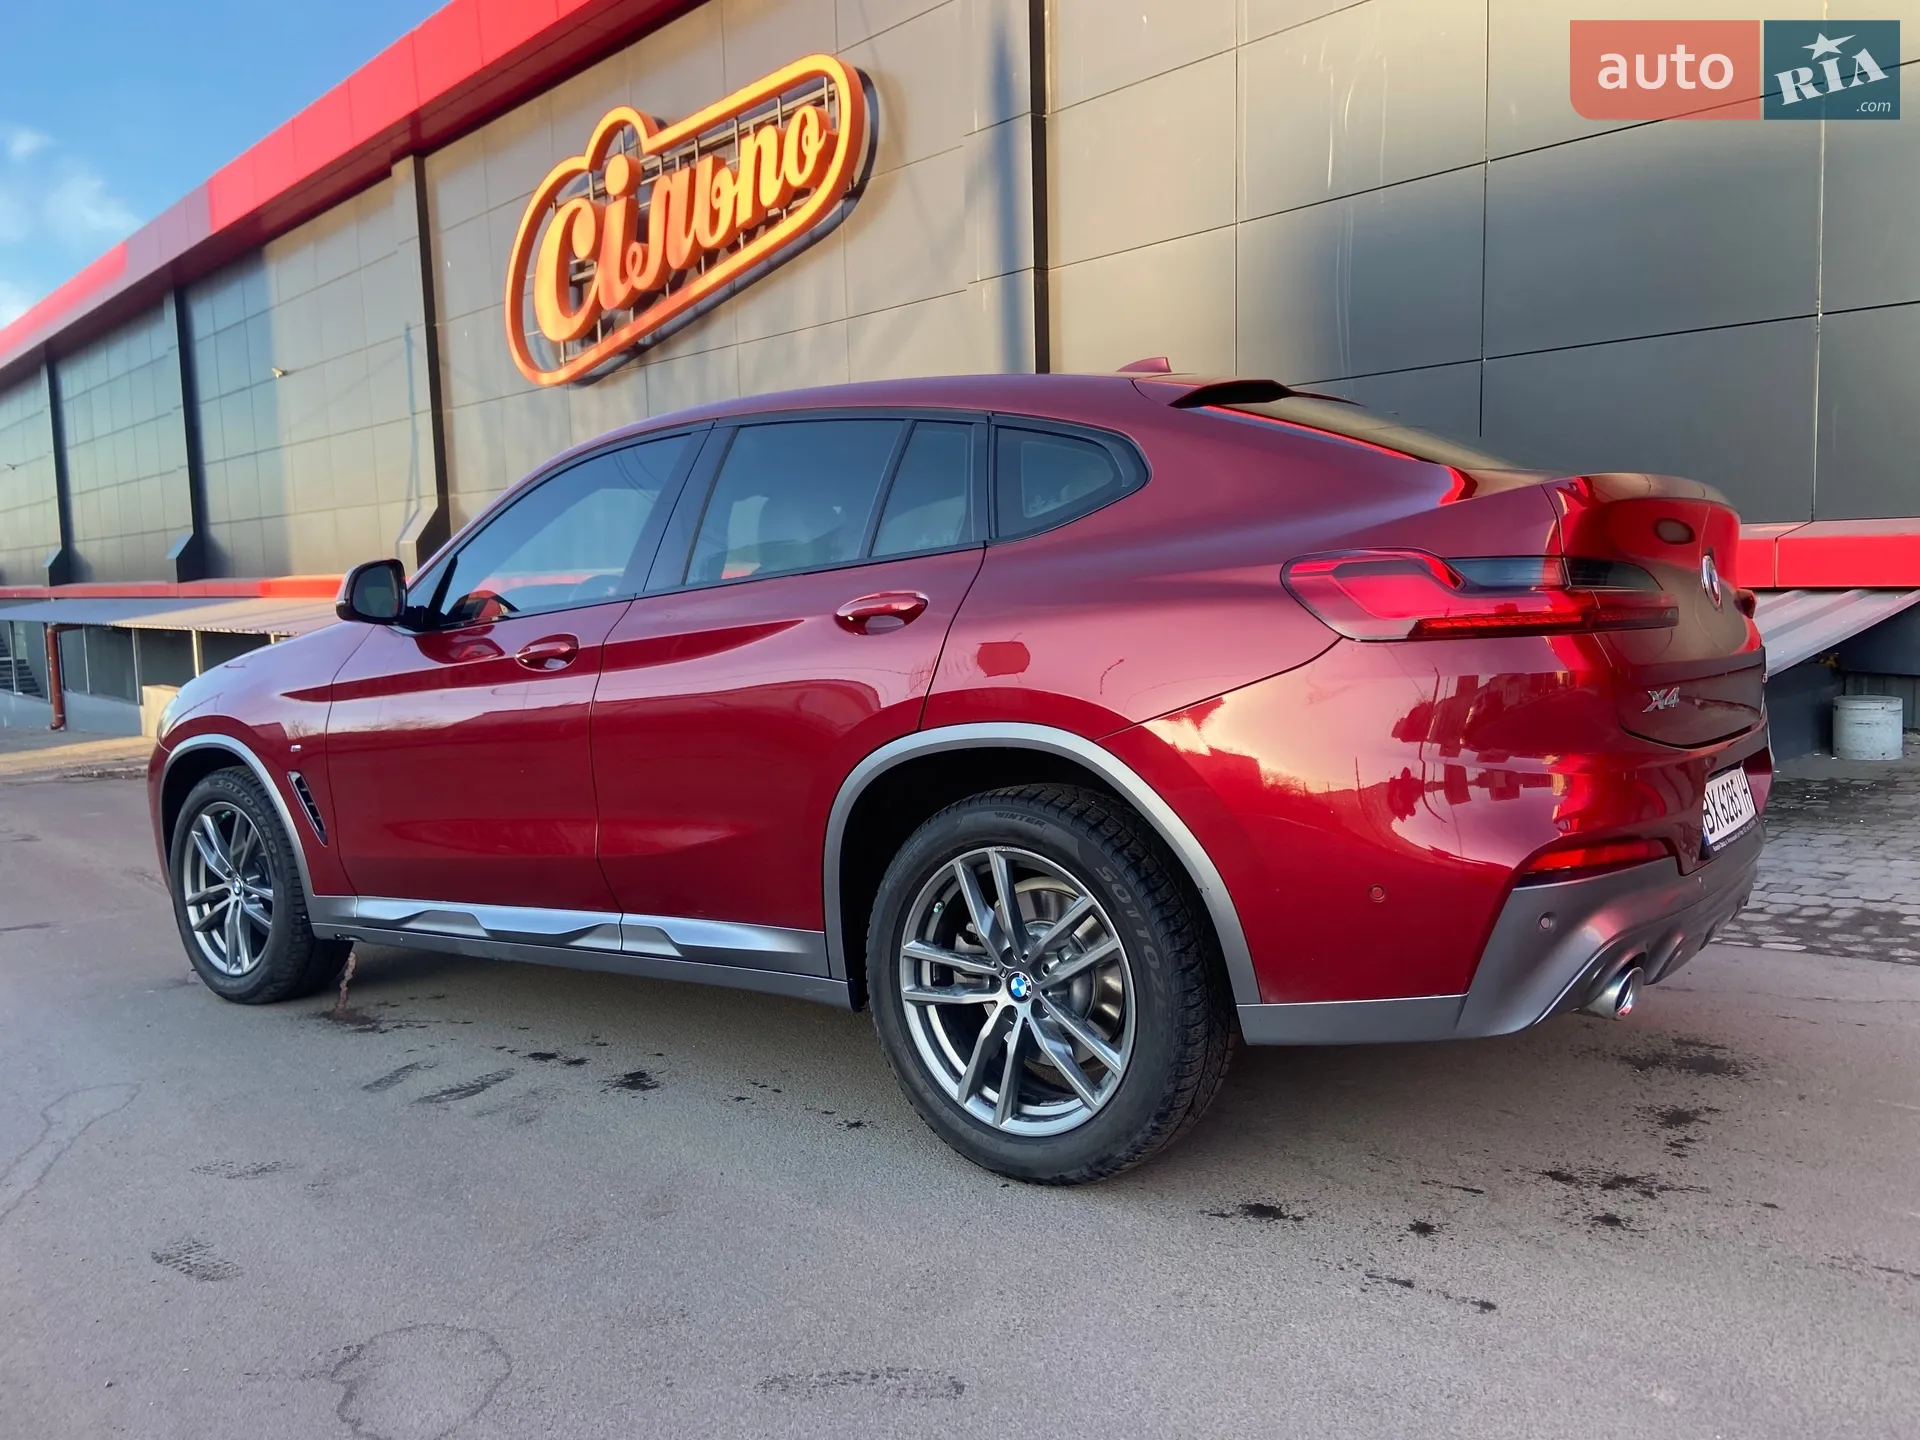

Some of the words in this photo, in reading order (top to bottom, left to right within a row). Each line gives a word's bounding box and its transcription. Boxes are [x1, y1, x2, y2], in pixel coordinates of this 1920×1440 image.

[533, 104, 832, 342] Сільпо
[1642, 686, 1680, 713] X4
[994, 811, 1047, 828] WINTER
[1717, 778, 1743, 825] 6285
